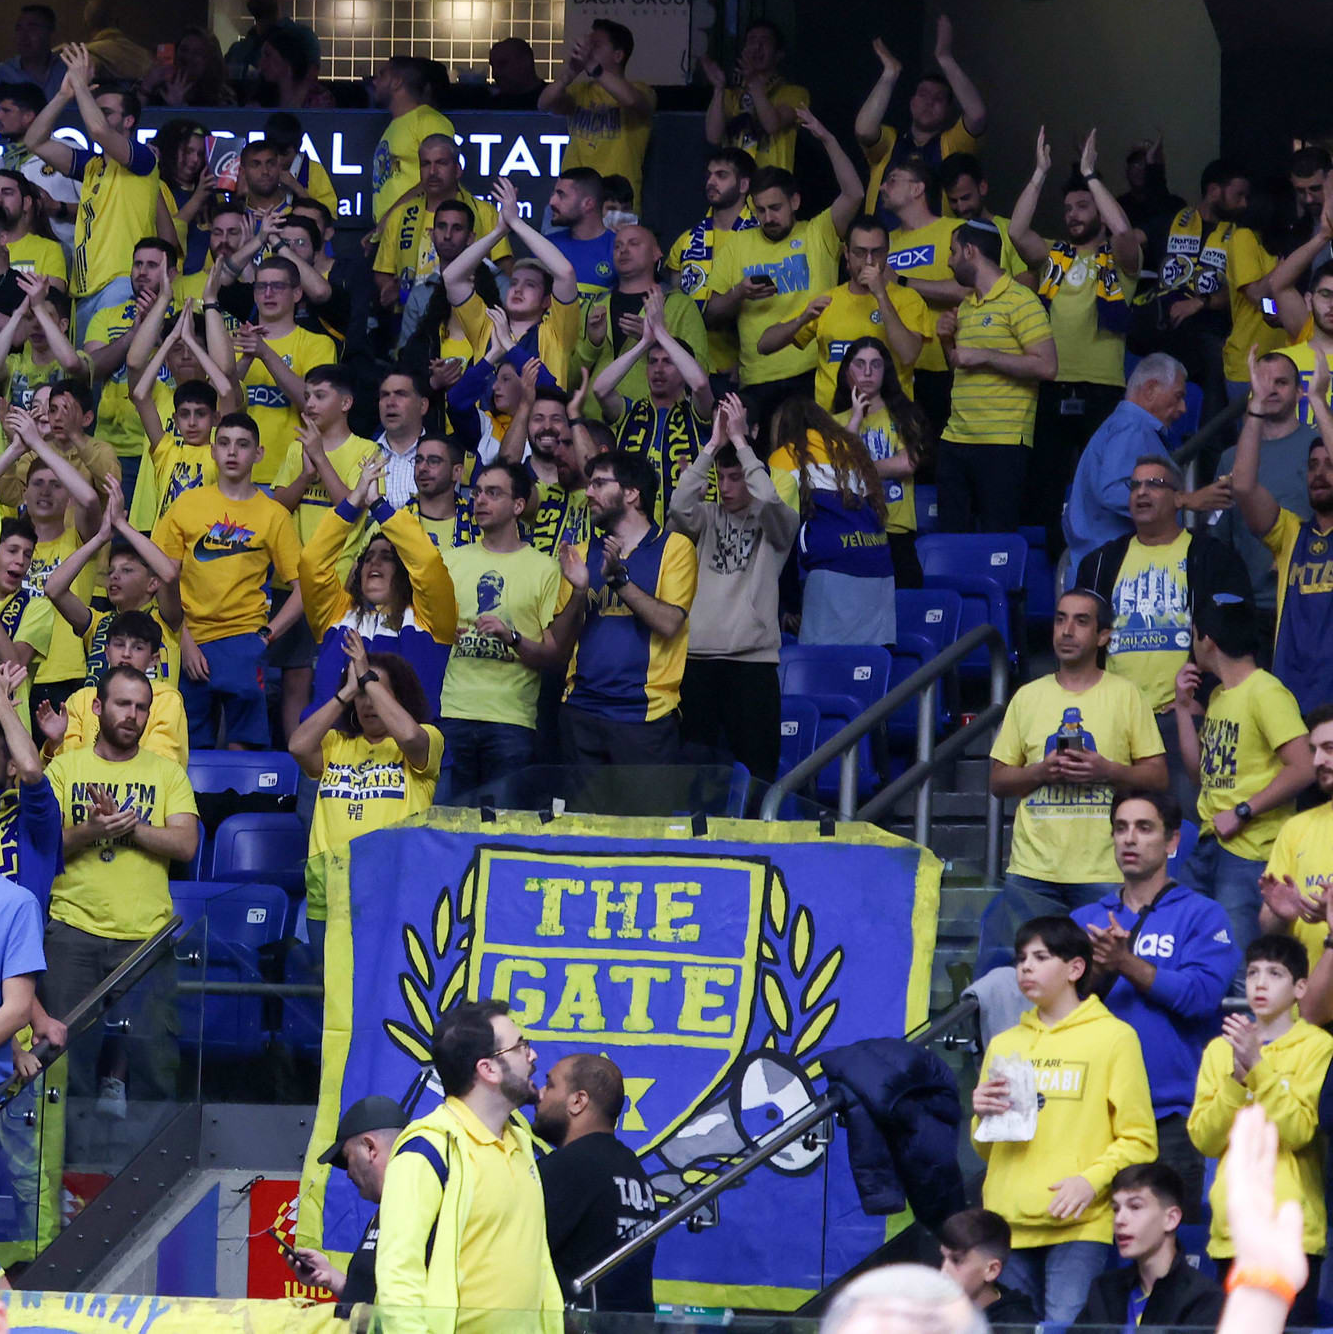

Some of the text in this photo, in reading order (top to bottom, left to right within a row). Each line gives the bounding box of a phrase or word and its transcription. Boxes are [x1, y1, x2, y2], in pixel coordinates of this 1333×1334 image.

[886, 248, 930, 268] FOX
[1119, 633, 1168, 645] MILANO
[523, 876, 702, 945] THE
[491, 958, 735, 1036] GATE
[1044, 1057, 1063, 1068] ARE
